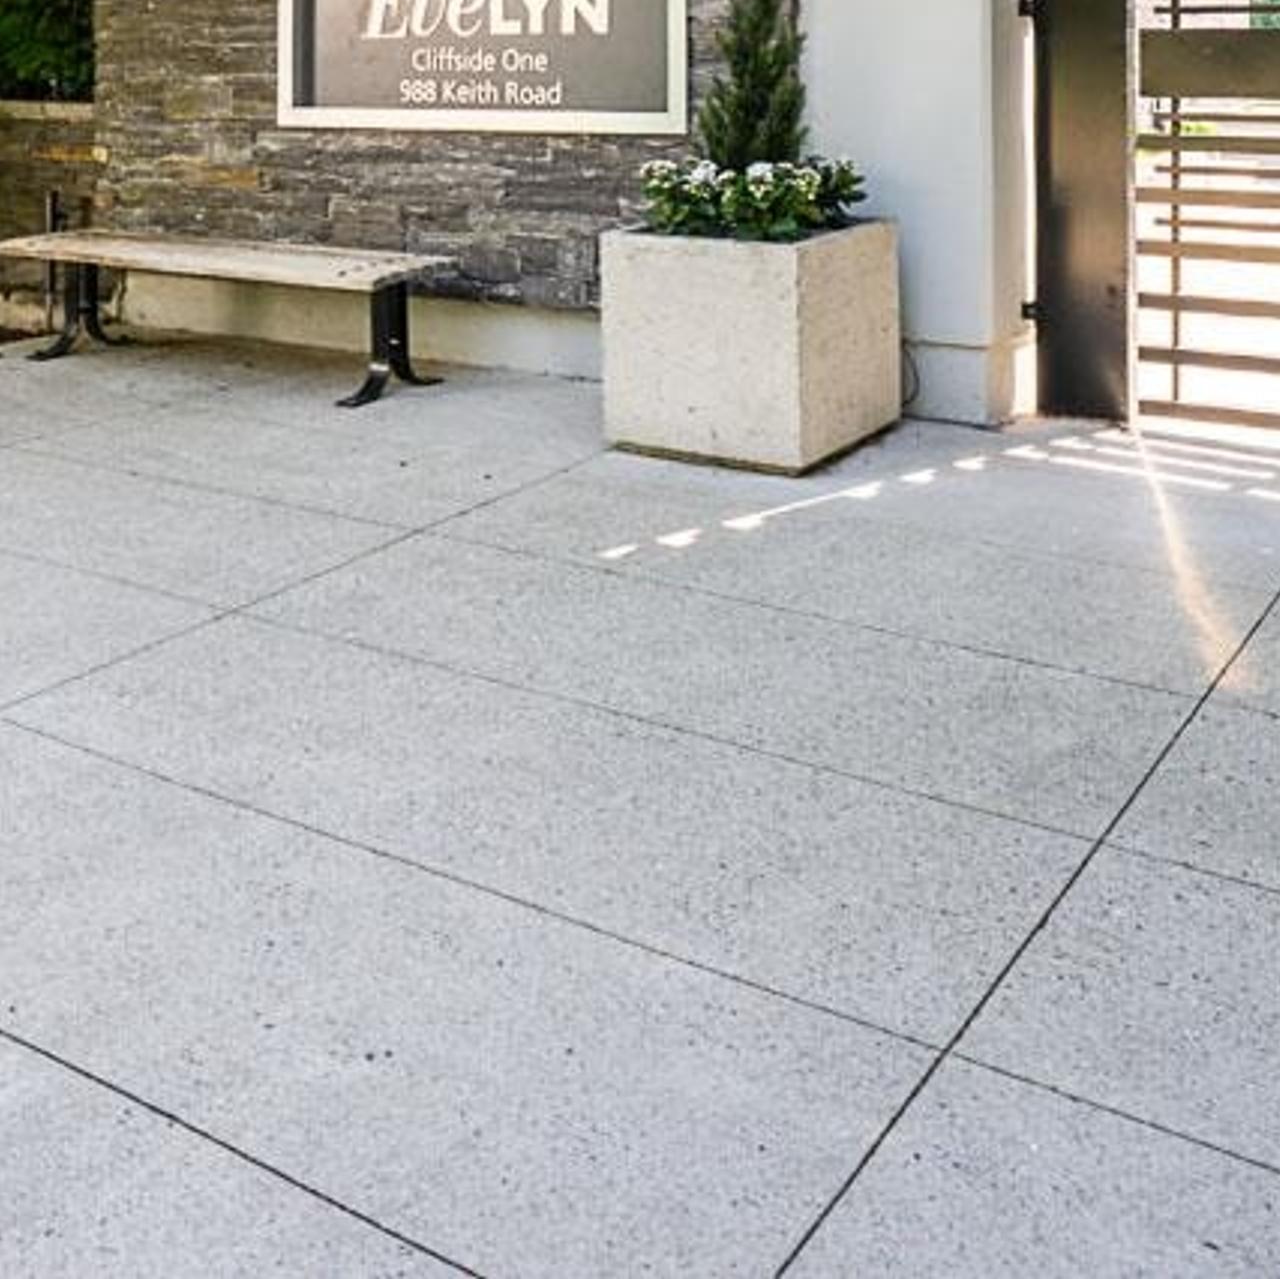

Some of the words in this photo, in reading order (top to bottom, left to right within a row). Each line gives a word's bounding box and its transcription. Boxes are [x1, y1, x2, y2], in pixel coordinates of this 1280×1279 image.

[411, 47, 496, 72] Cliffside
[501, 48, 548, 72] One
[399, 79, 437, 103] 988
[441, 79, 499, 104] Keith
[504, 79, 562, 105] Road
